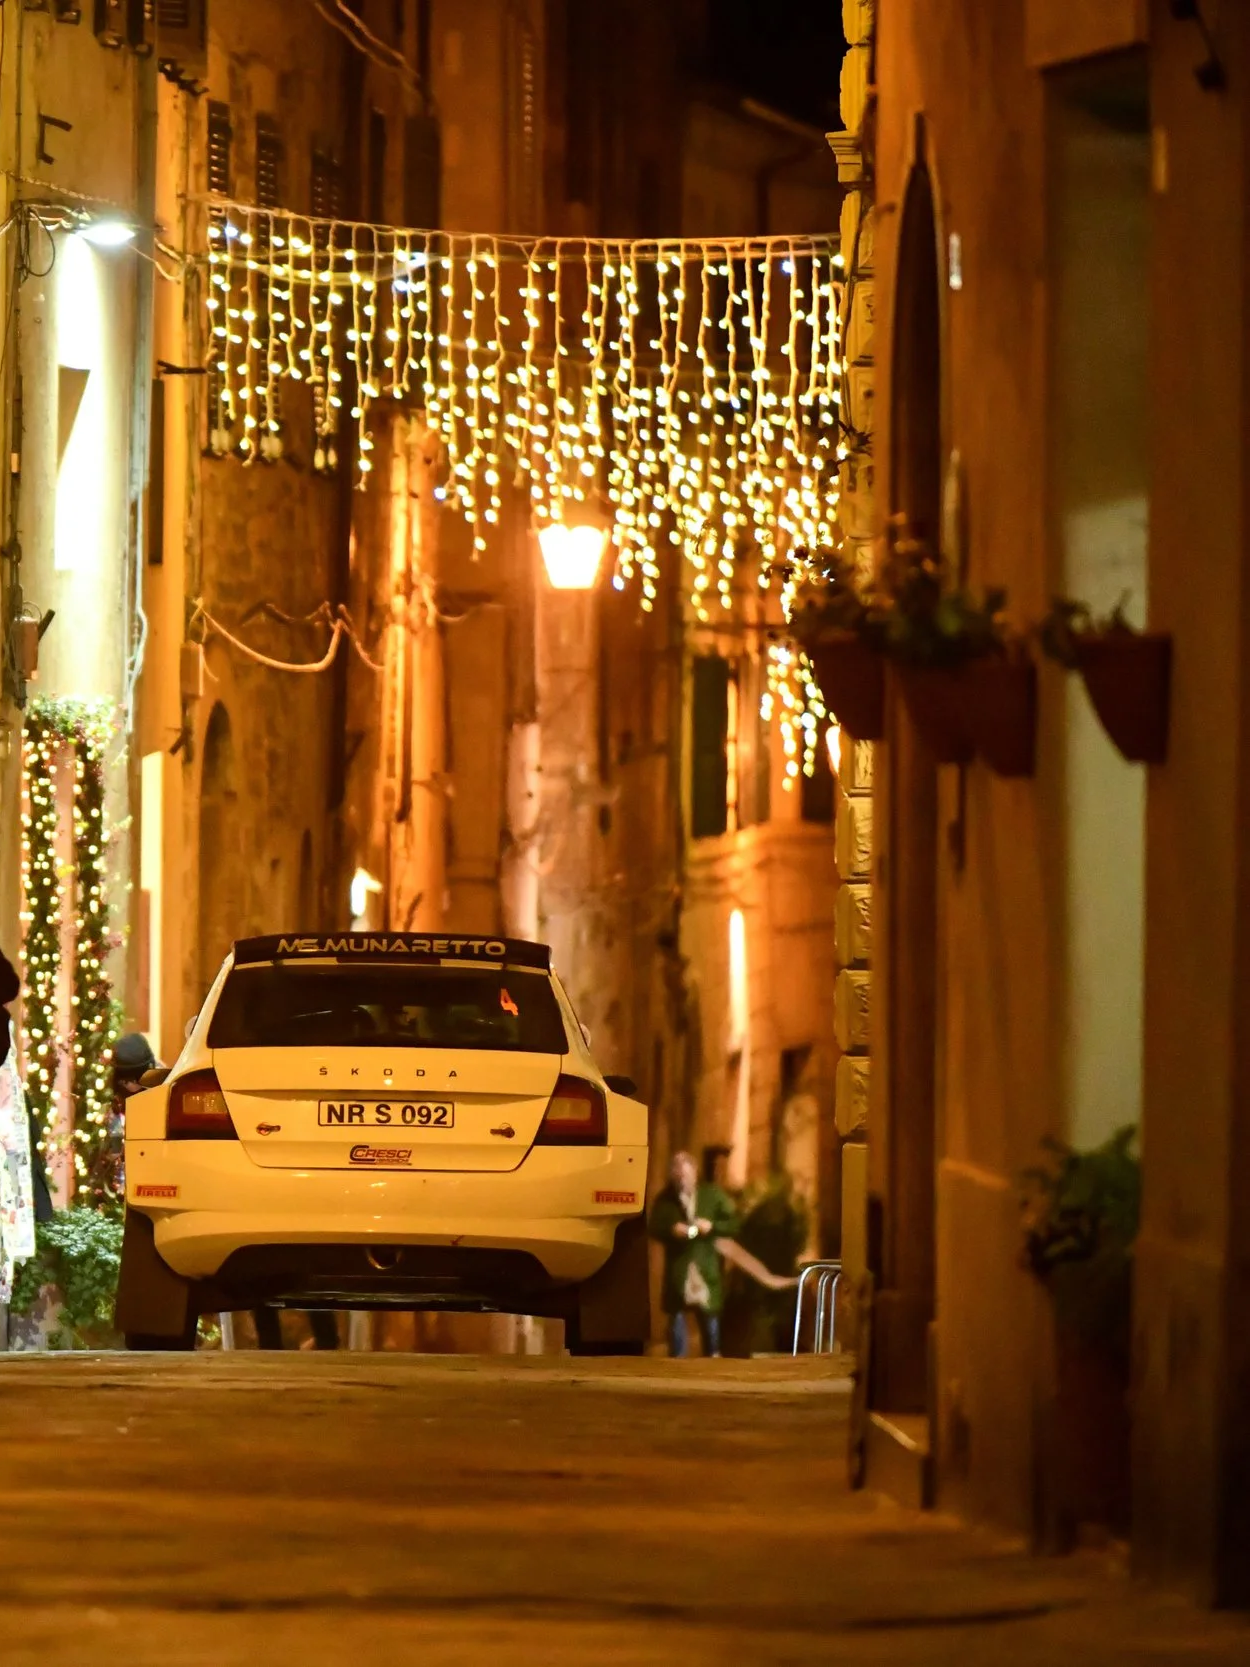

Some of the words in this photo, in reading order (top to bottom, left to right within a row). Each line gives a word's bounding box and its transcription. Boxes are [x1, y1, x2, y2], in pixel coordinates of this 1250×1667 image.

[323, 937, 506, 956] MUNARETTO
[500, 987, 519, 1016] 4
[326, 1103, 365, 1124] NR
[375, 1103, 392, 1124] S
[401, 1104, 448, 1125] 092
[350, 1145, 412, 1161] CRESCI
